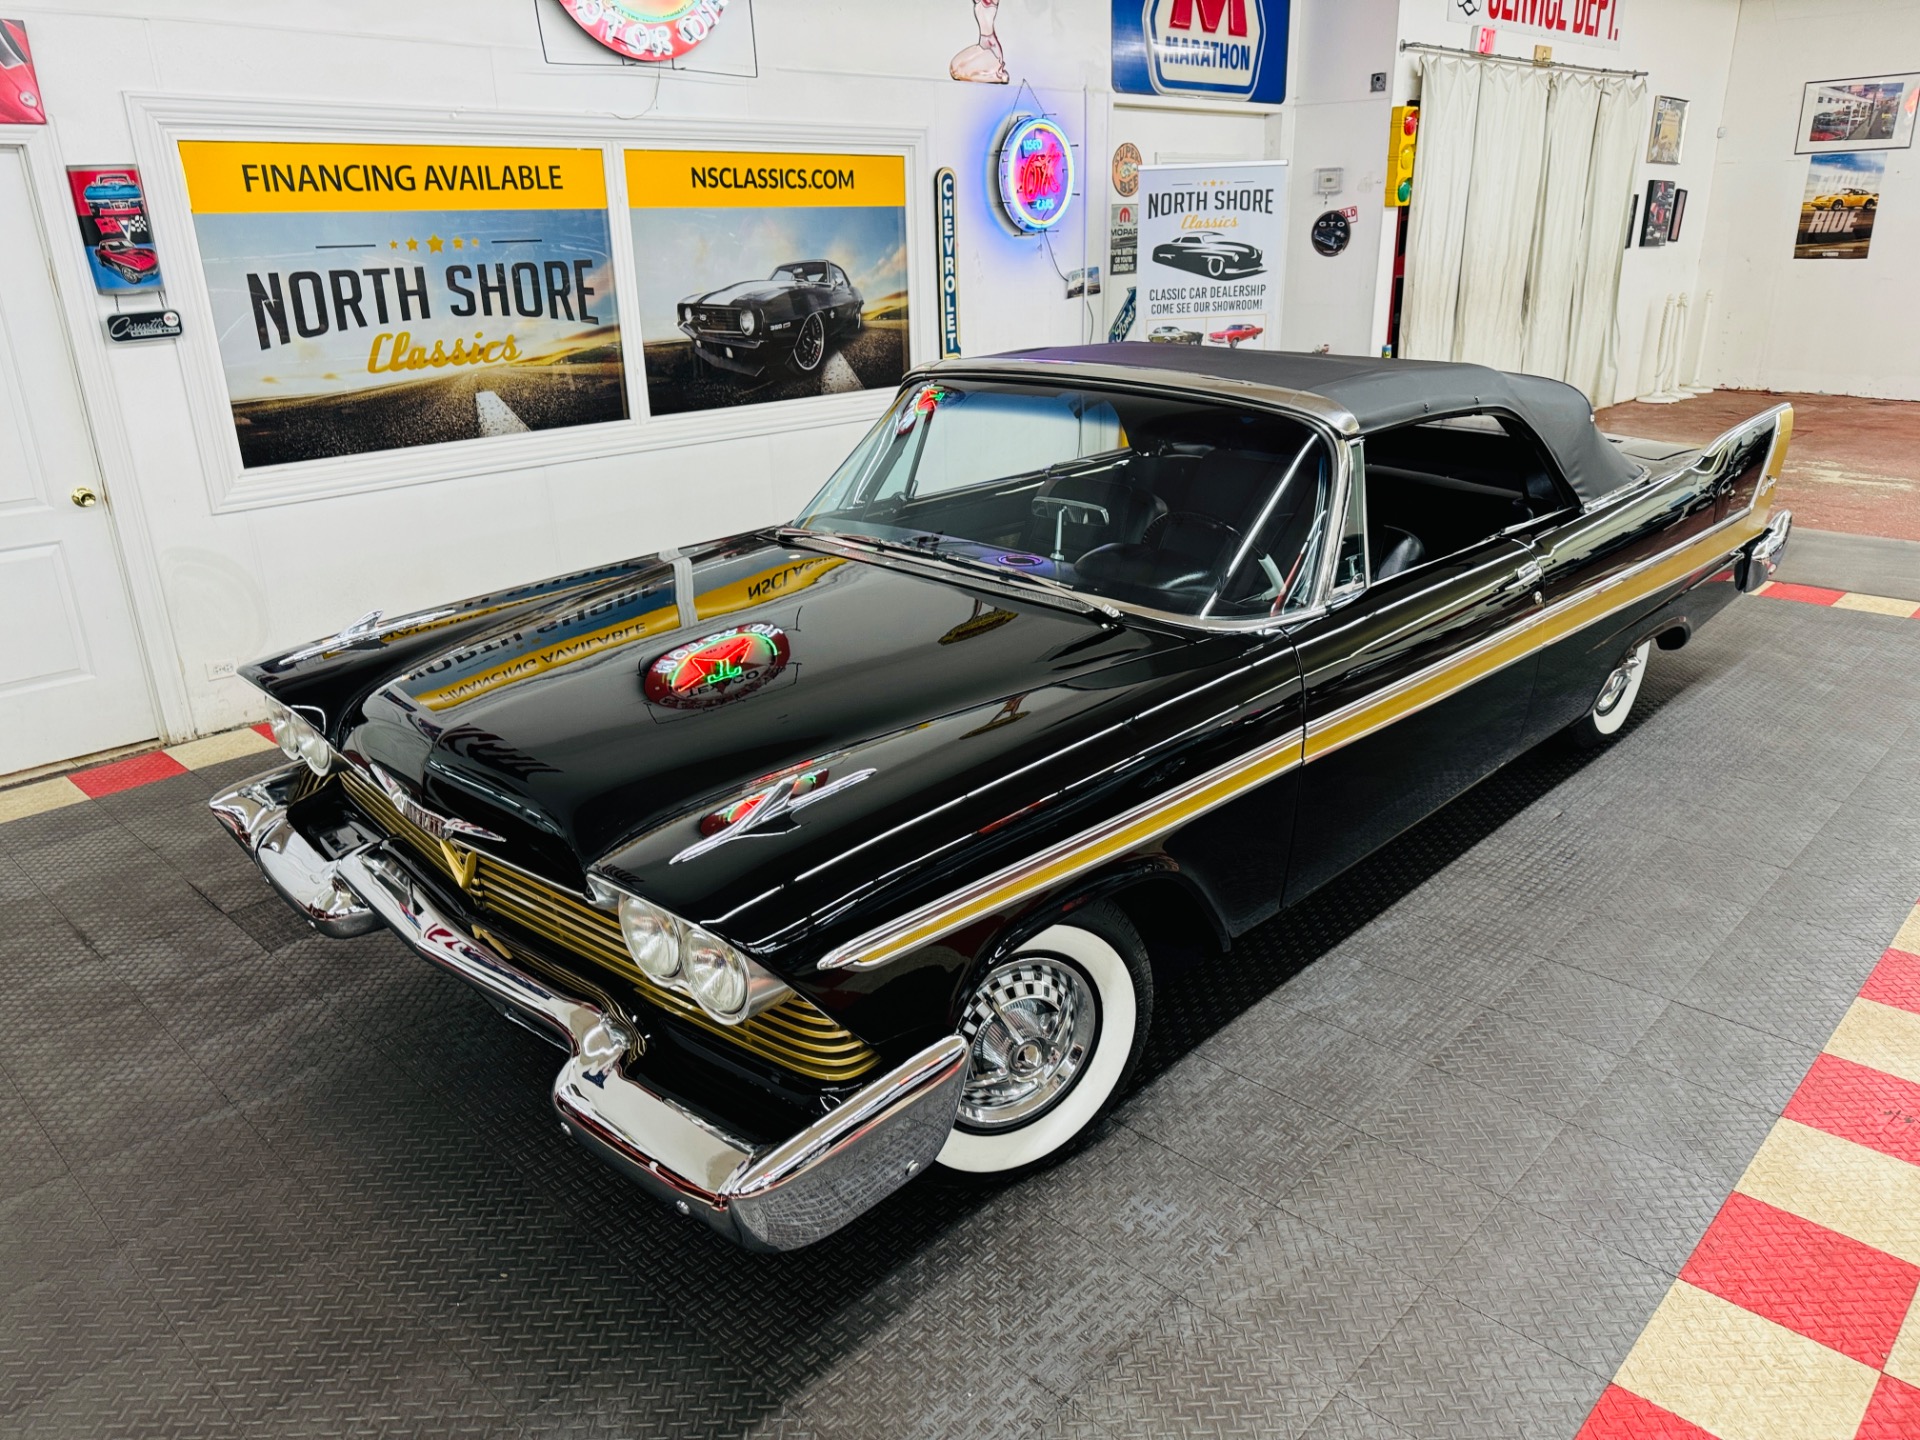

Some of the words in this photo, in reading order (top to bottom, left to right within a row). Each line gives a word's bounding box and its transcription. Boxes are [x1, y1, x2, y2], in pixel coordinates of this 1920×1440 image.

[576, 0, 674, 57] OTOR
[1163, 35, 1251, 71] MARATHON
[242, 164, 416, 192] FINANCING
[424, 165, 564, 191] AVAILABLE
[691, 166, 854, 189] NSCLASSICS.COM
[1148, 190, 1207, 219] NORTH
[1214, 189, 1274, 214] SHORE
[1181, 214, 1238, 229] Classics
[1808, 210, 1859, 233] RIDE
[943, 179, 957, 350] CHEVROLET
[246, 266, 431, 351] NORTH
[445, 259, 599, 325] SHORE
[1150, 288, 1186, 301] CLASSIC
[1189, 287, 1207, 299] CAR
[1210, 284, 1266, 298] DEALERSHIP
[1151, 303, 1173, 315] COME
[1176, 302, 1191, 313] SEE
[1193, 302, 1210, 312] OUR
[1212, 299, 1262, 311] SHOWROOM!
[110, 316, 165, 337] Corvette
[366, 331, 523, 374] Classics
